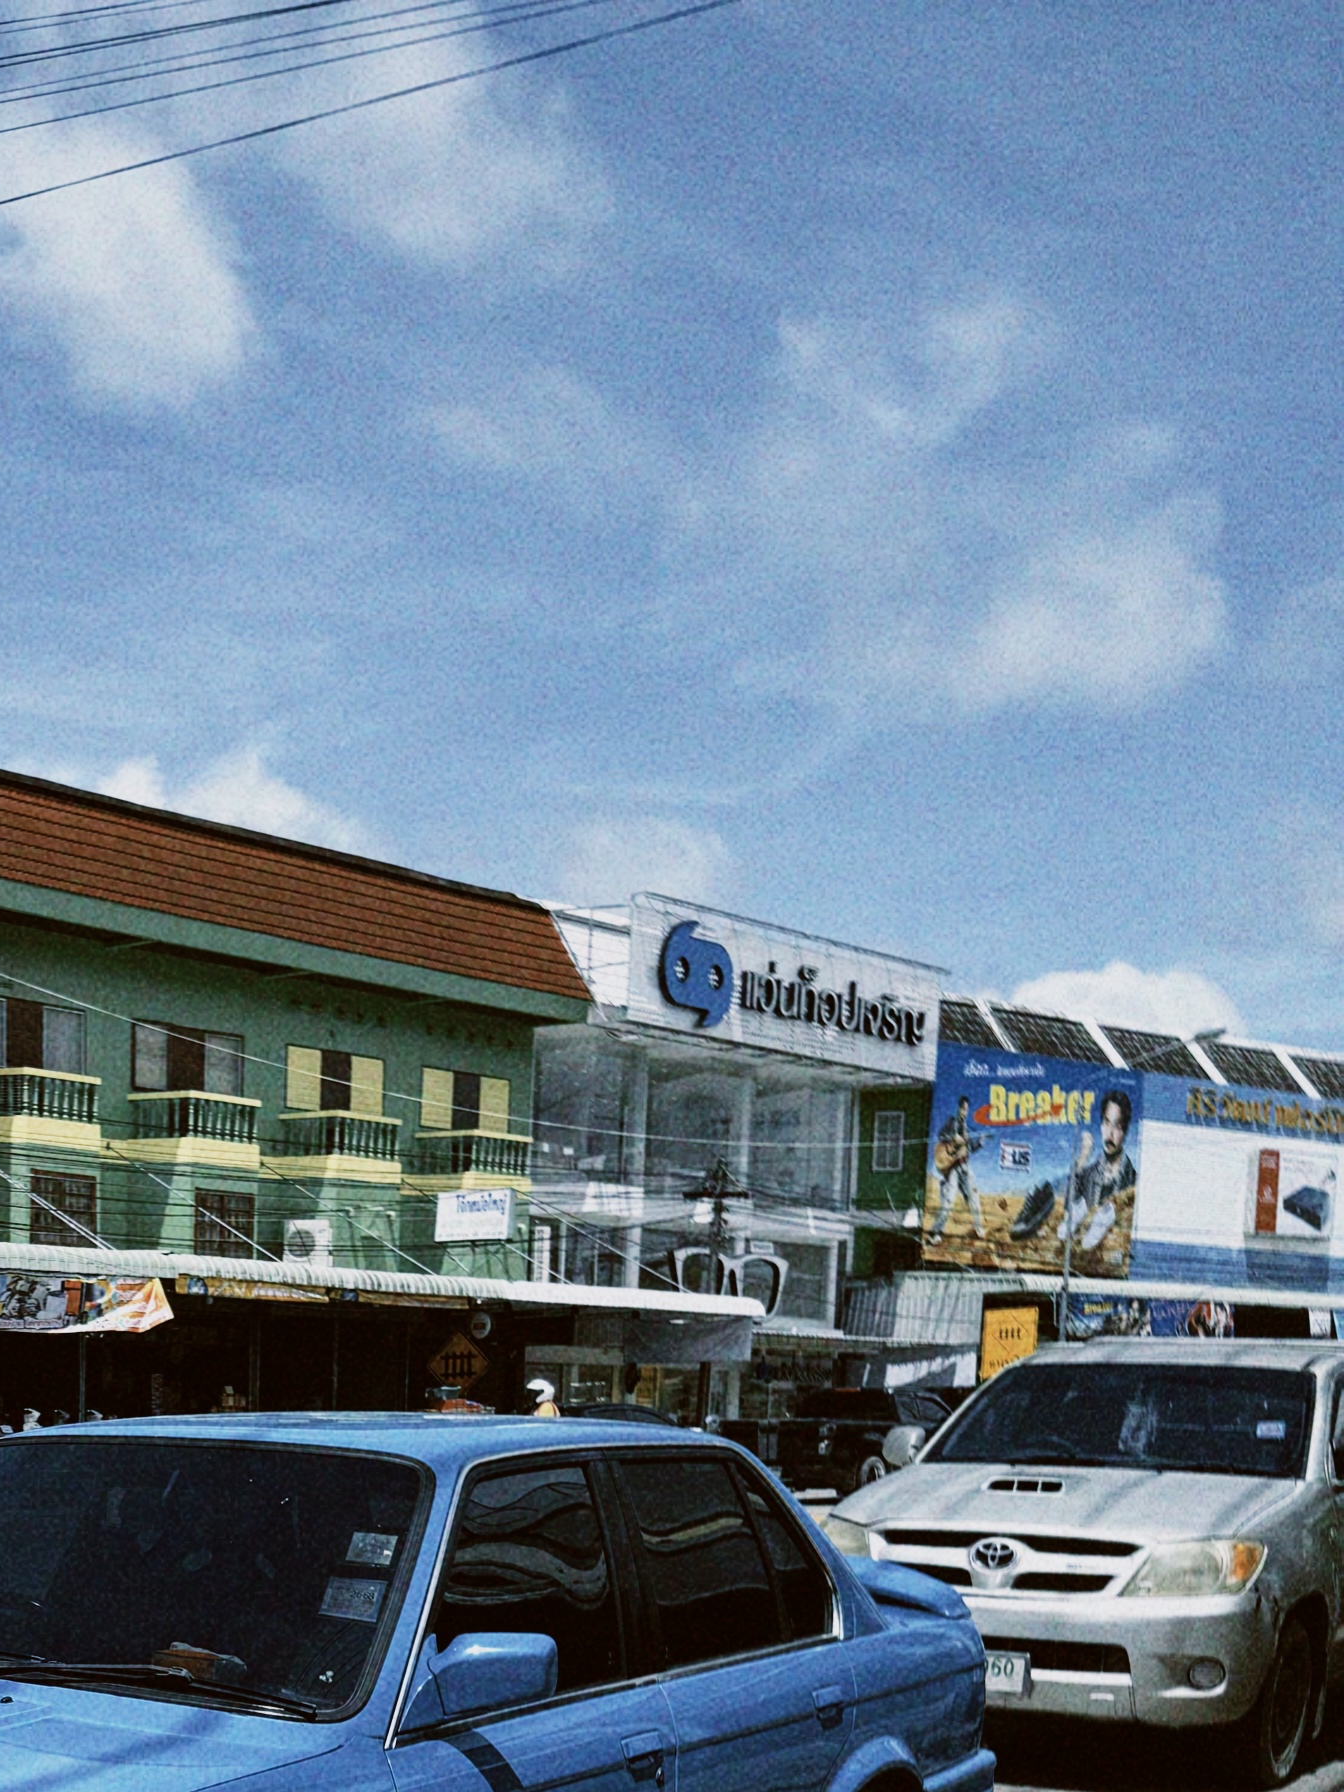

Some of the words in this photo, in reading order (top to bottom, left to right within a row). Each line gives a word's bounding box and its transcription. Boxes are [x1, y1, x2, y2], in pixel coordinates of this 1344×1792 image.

[740, 960, 927, 1047] แว่นท็อปเจริญ
[989, 1083, 1095, 1126] Breaker
